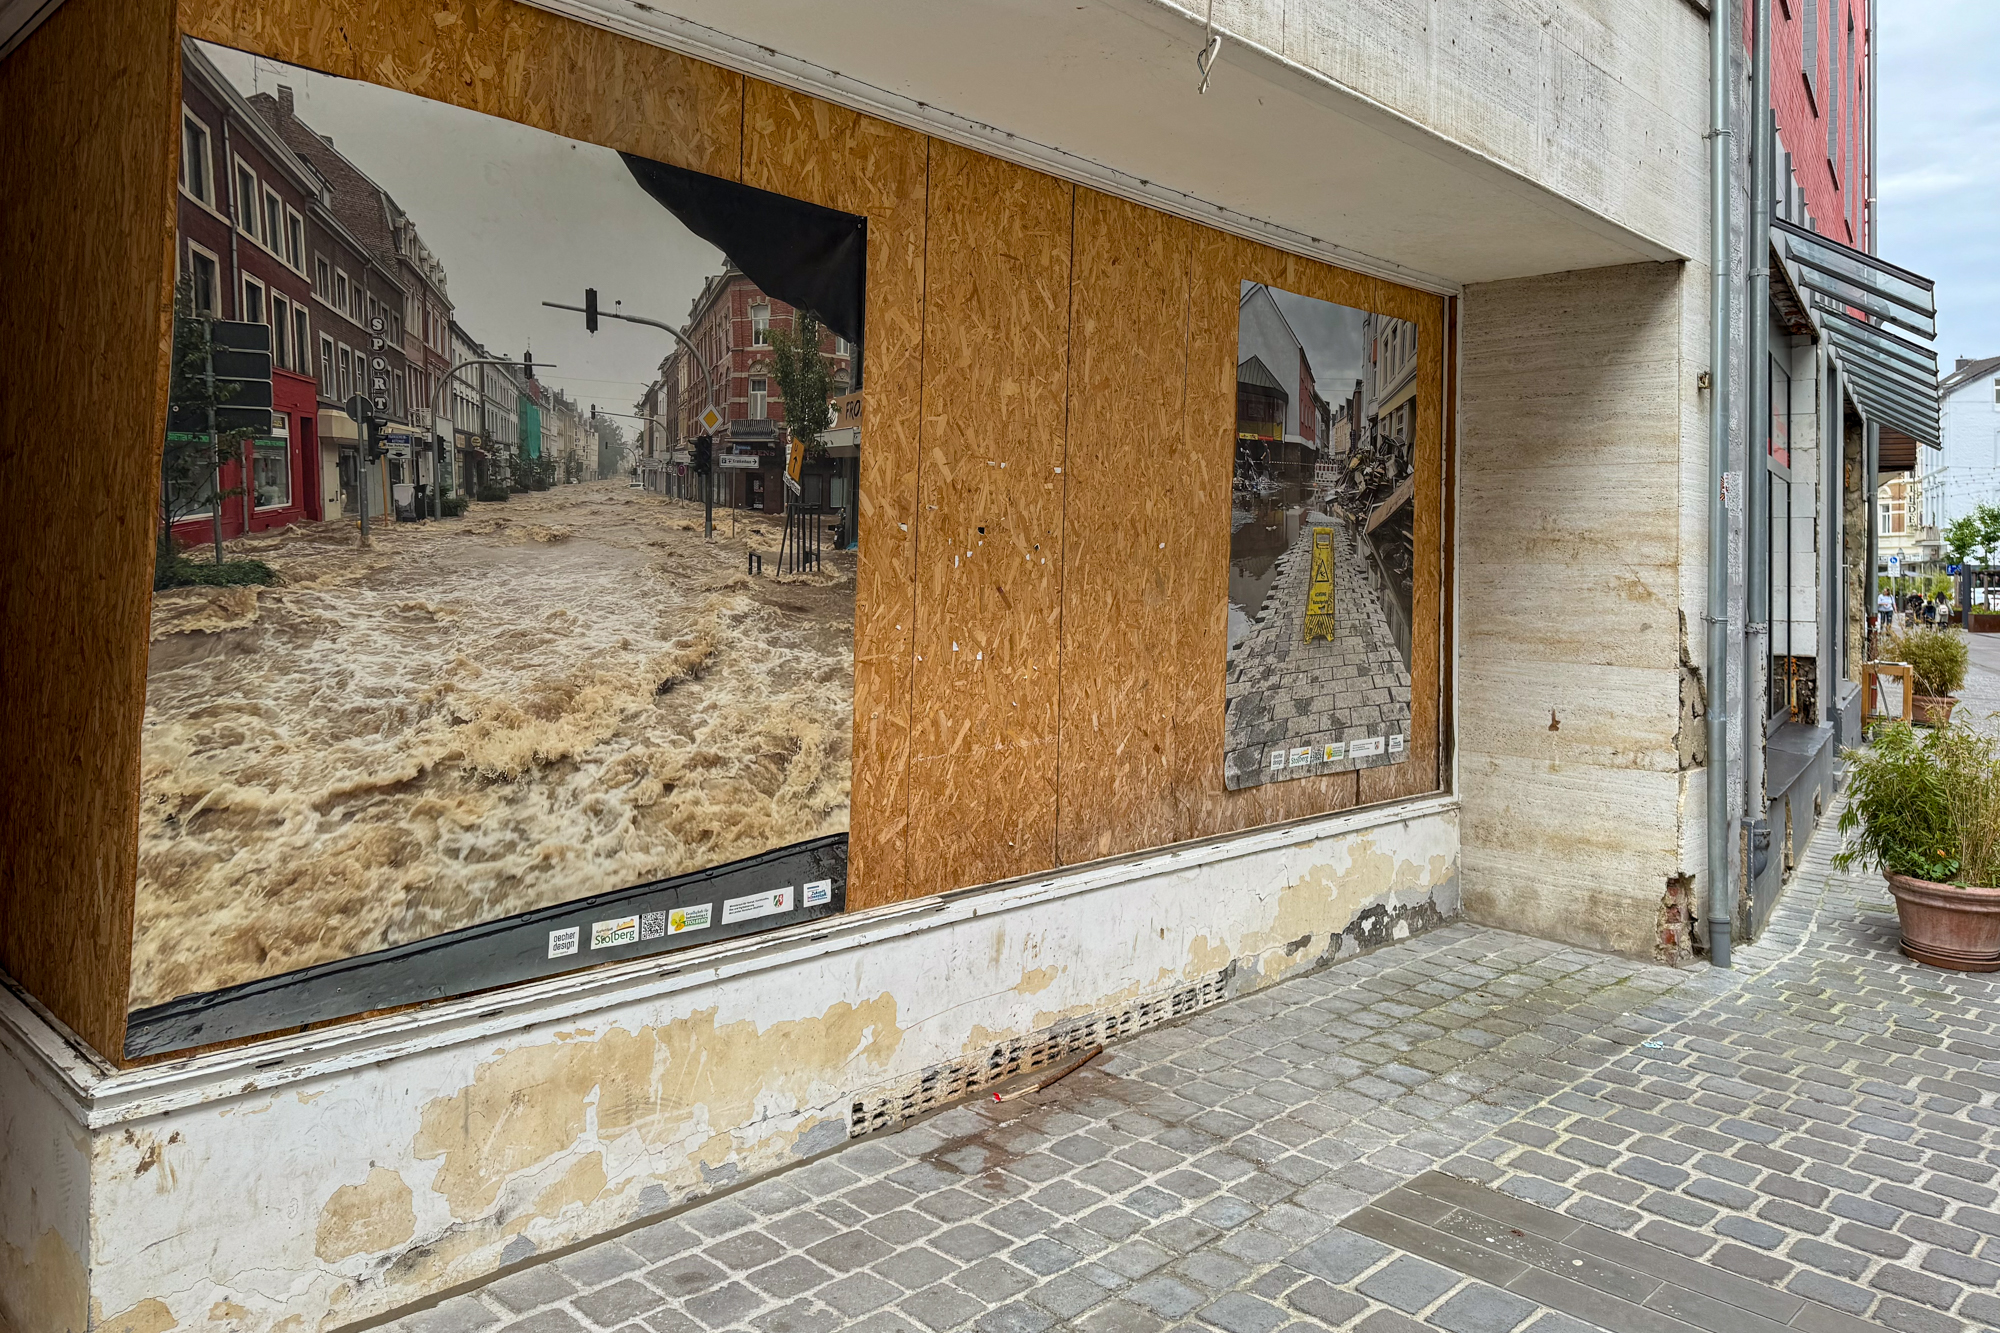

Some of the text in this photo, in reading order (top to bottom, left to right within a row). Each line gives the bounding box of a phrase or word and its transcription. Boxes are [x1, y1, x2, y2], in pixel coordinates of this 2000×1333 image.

[371, 317, 386, 410] SPORT
[846, 399, 862, 420] FRO
[552, 941, 575, 951] design
[594, 929, 635, 946] Stolberg
